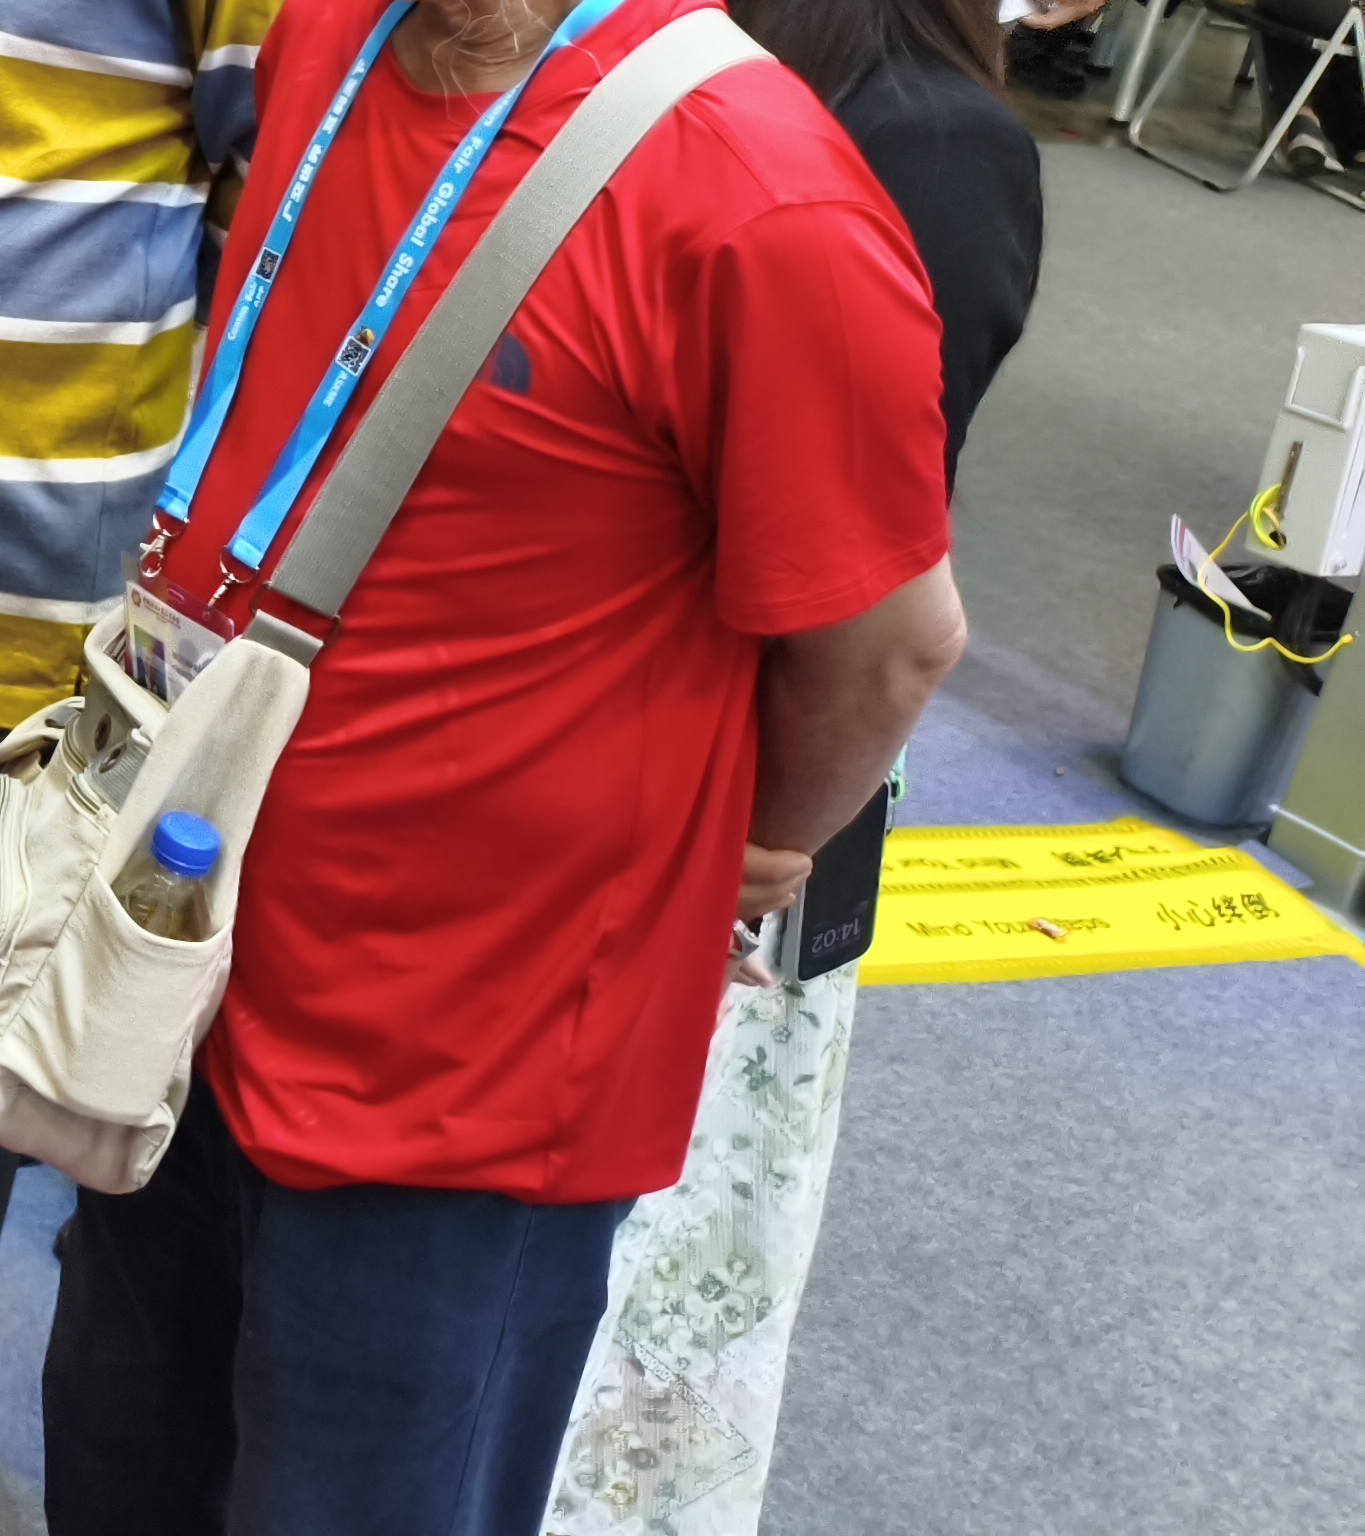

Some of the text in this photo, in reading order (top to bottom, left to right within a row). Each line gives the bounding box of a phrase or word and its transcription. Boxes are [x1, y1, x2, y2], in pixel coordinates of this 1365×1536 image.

[454, 135, 484, 175] Fair
[410, 181, 455, 248] Global
[375, 252, 415, 307] Share
